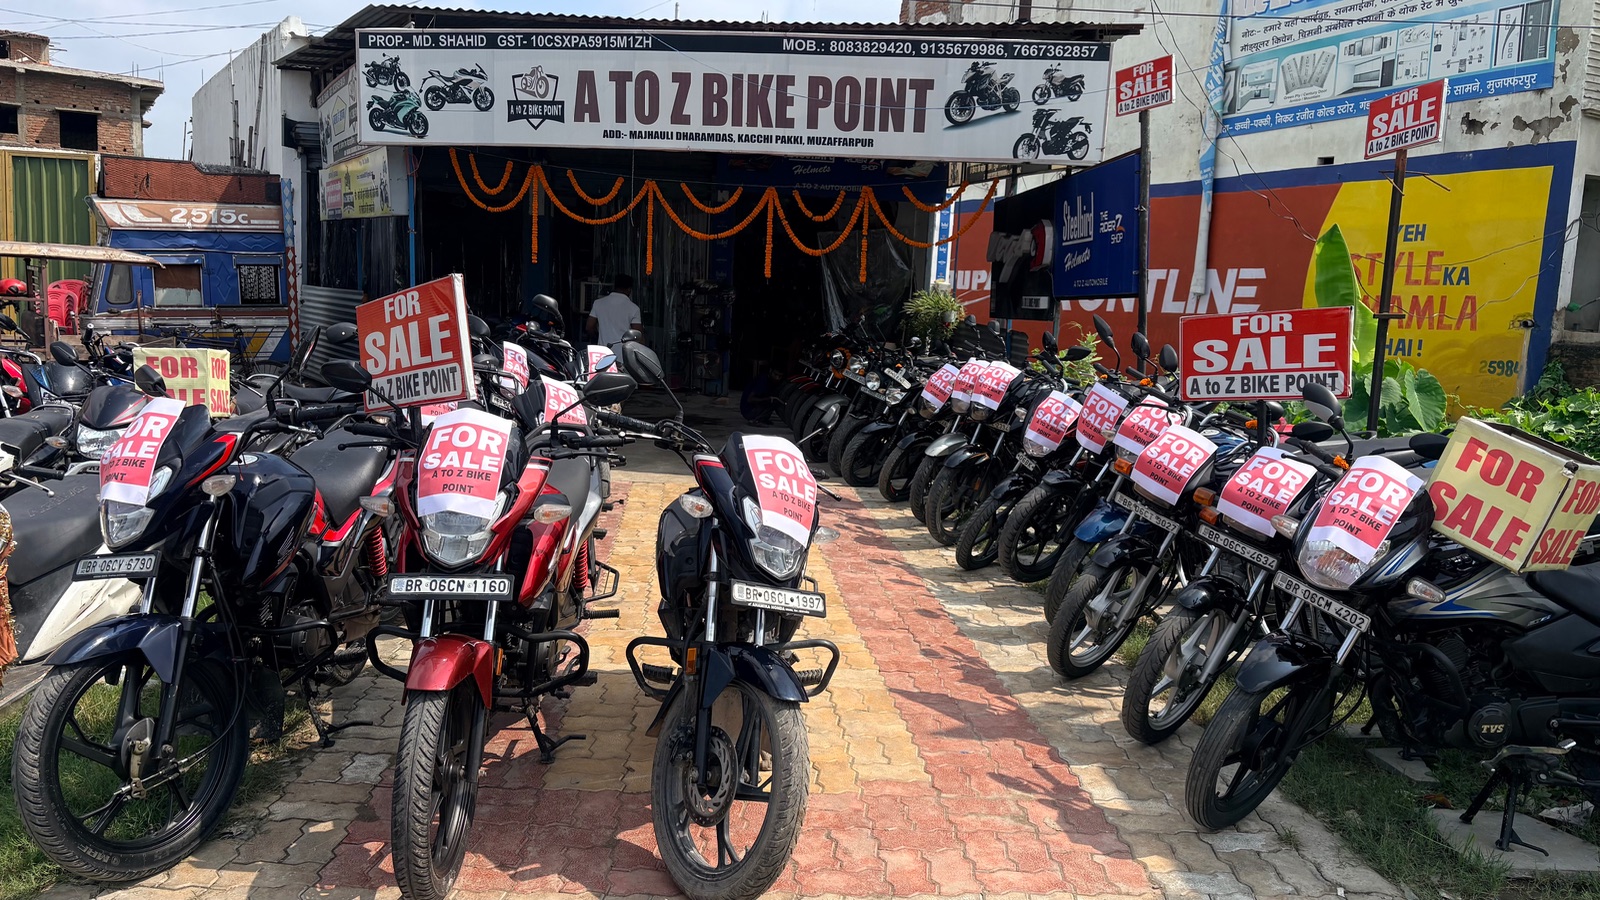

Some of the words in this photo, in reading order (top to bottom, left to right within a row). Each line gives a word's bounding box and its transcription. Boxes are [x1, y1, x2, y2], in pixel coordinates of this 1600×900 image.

[368, 34, 410, 47] PROP.-
[413, 35, 435, 47] MD.
[438, 35, 487, 47] SHAHID
[497, 35, 528, 47] GST-
[530, 35, 652, 49] 10CSXPA5915M1ZH
[829, 40, 916, 55] 8083829420,
[920, 43, 1007, 57] 9135679986,
[1012, 44, 1098, 58] 7667362857
[1133, 62, 1154, 78] FOR
[1120, 69, 1168, 100] SALE
[573, 70, 601, 123] A
[609, 69, 660, 125] TO
[670, 72, 692, 126] Z
[702, 72, 796, 130] BIKE
[807, 75, 935, 133] POINT
[1136, 96, 1150, 108] BIKE
[1151, 90, 1169, 105] POINT
[1391, 88, 1418, 108] FOR
[510, 104, 515, 115] A
[523, 104, 528, 115] Z
[528, 104, 542, 115] BIKE
[543, 104, 562, 116] POINT
[1372, 97, 1437, 138] SALE
[628, 130, 674, 141] MAJHAULI
[675, 131, 736, 144] DHARAMDAS,
[737, 133, 773, 145] KACCHI
[775, 135, 805, 146] PAKKI,
[806, 136, 874, 148] MUZAFFARPUR
[1368, 141, 1375, 153] A
[1376, 139, 1383, 152] to
[1384, 137, 1390, 150] Z
[1391, 132, 1409, 148] BIKE
[1410, 123, 1436, 144] POINT
[1062, 192, 1094, 242] Steelbird
[1100, 210, 1109, 221] THE
[1111, 233, 1123, 244] SHOP
[1064, 247, 1091, 272] Helmets
[1443, 266, 1470, 286] KA
[383, 290, 421, 324] FOR
[1232, 313, 1293, 335] FOR
[364, 313, 454, 375] SALE
[1192, 333, 1336, 373] SALE
[146, 356, 198, 378] FOR
[211, 357, 227, 380] FOR
[984, 367, 1013, 382] FOR
[386, 378, 395, 400] Z
[396, 372, 420, 400] BIKE
[422, 366, 457, 395] POINT
[931, 376, 952, 394] SALE
[979, 375, 1007, 392] SALE
[1190, 378, 1200, 395] A
[1205, 378, 1220, 395] to
[1225, 376, 1235, 393] Z
[1240, 374, 1279, 394] BIKE
[1286, 373, 1339, 393] POINT
[210, 389, 229, 413] SALE
[1042, 398, 1075, 424] FOR
[1087, 394, 1119, 421] FOR
[124, 415, 169, 439] OR
[1036, 409, 1067, 430] SALE
[1049, 425, 1061, 436] BIKE
[1081, 408, 1112, 431] SALE
[431, 425, 503, 455] FOR
[1037, 428, 1051, 438] POINT
[1082, 429, 1095, 440] POINT
[102, 440, 159, 465] SALE
[1158, 434, 1204, 465] FOR
[122, 458, 146, 468] BIKE
[423, 451, 499, 472] SALE
[754, 450, 813, 483] FOR
[1146, 446, 1195, 478] SALE
[1154, 461, 1162, 470] TO
[1162, 465, 1168, 473] Z
[1167, 468, 1182, 482] BIKE
[1455, 436, 1545, 503] FOR
[432, 470, 438, 479] A
[441, 469, 453, 477] TO
[456, 469, 463, 477] Z
[466, 471, 492, 481] BIKE
[1150, 471, 1169, 486] POINT
[1246, 456, 1303, 491] FOR
[442, 483, 474, 494] POINT
[758, 473, 815, 504] SALE
[1235, 471, 1294, 504] SALE
[1342, 470, 1407, 507] FOR
[1561, 479, 1600, 515] FOR
[779, 492, 789, 502] TO
[791, 496, 796, 504] Z
[798, 498, 811, 513] BIKE
[1241, 500, 1265, 516] POINT
[1244, 489, 1255, 498] TO
[1255, 493, 1262, 501] Z
[1261, 496, 1281, 510] BIKE
[1329, 491, 1399, 526] SALE
[783, 507, 803, 521] POINT
[1330, 506, 1336, 514] A
[1338, 506, 1350, 515] TO
[1351, 508, 1359, 517] Z
[1359, 513, 1383, 532] BIKE
[1429, 481, 1531, 561] SALE
[1332, 518, 1362, 536] POINT
[1208, 530, 1220, 542] BR
[1223, 538, 1246, 555] 06CS
[1249, 551, 1276, 568] 4634
[1531, 528, 1585, 565] SALE
[85, 561, 97, 573] BR
[126, 557, 153, 571] 6790
[405, 579, 422, 592] BR
[429, 579, 466, 592] 06CN
[472, 580, 507, 593] 1160
[745, 587, 758, 601] BR
[796, 595, 821, 609] 1997
[1285, 579, 1300, 594] BR
[1303, 589, 1333, 611] 06CM
[1334, 607, 1365, 629] 4202
[1481, 724, 1504, 734] TVS
